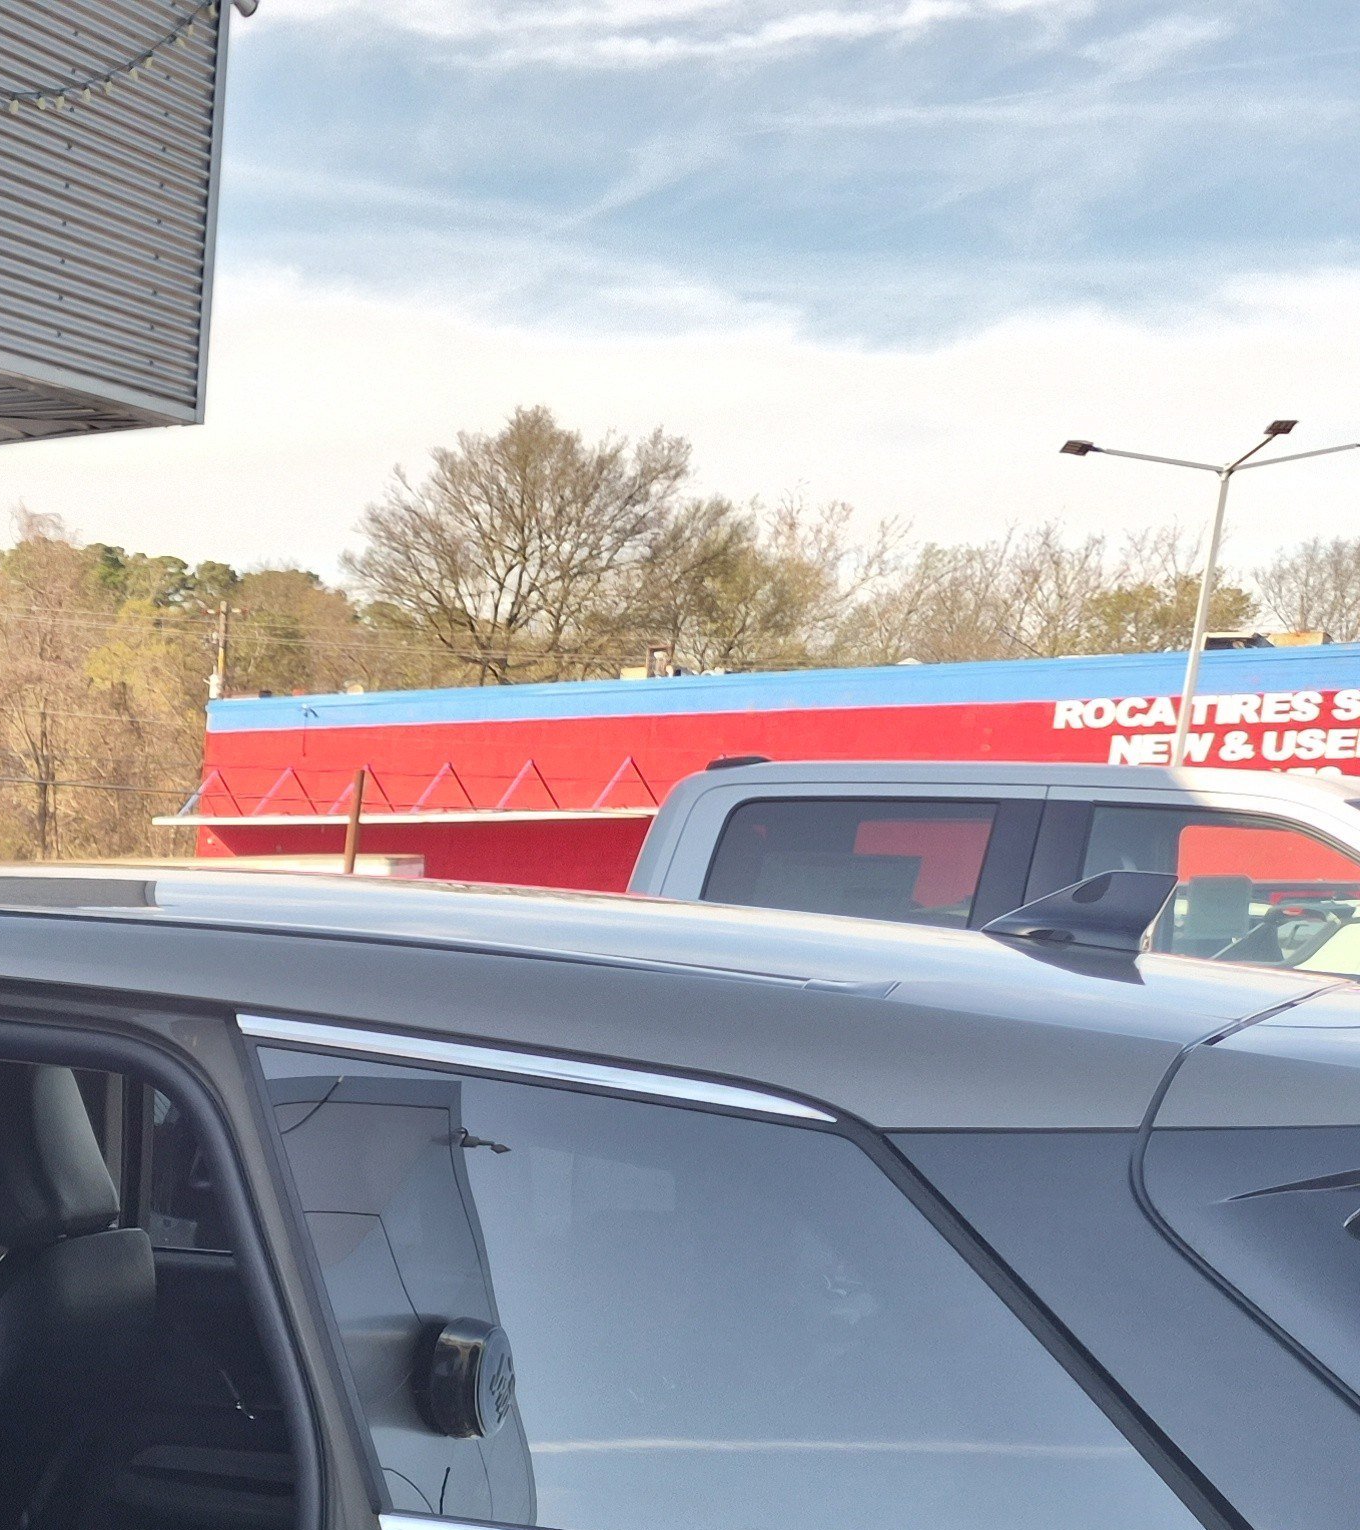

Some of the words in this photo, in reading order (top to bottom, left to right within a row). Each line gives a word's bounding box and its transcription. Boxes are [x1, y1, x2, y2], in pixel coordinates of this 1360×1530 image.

[1053, 697, 1177, 729] ROCA
[1191, 691, 1323, 725] TIRES
[1108, 732, 1215, 766] NEW
[1218, 731, 1255, 762] &
[1261, 728, 1360, 761] USE
